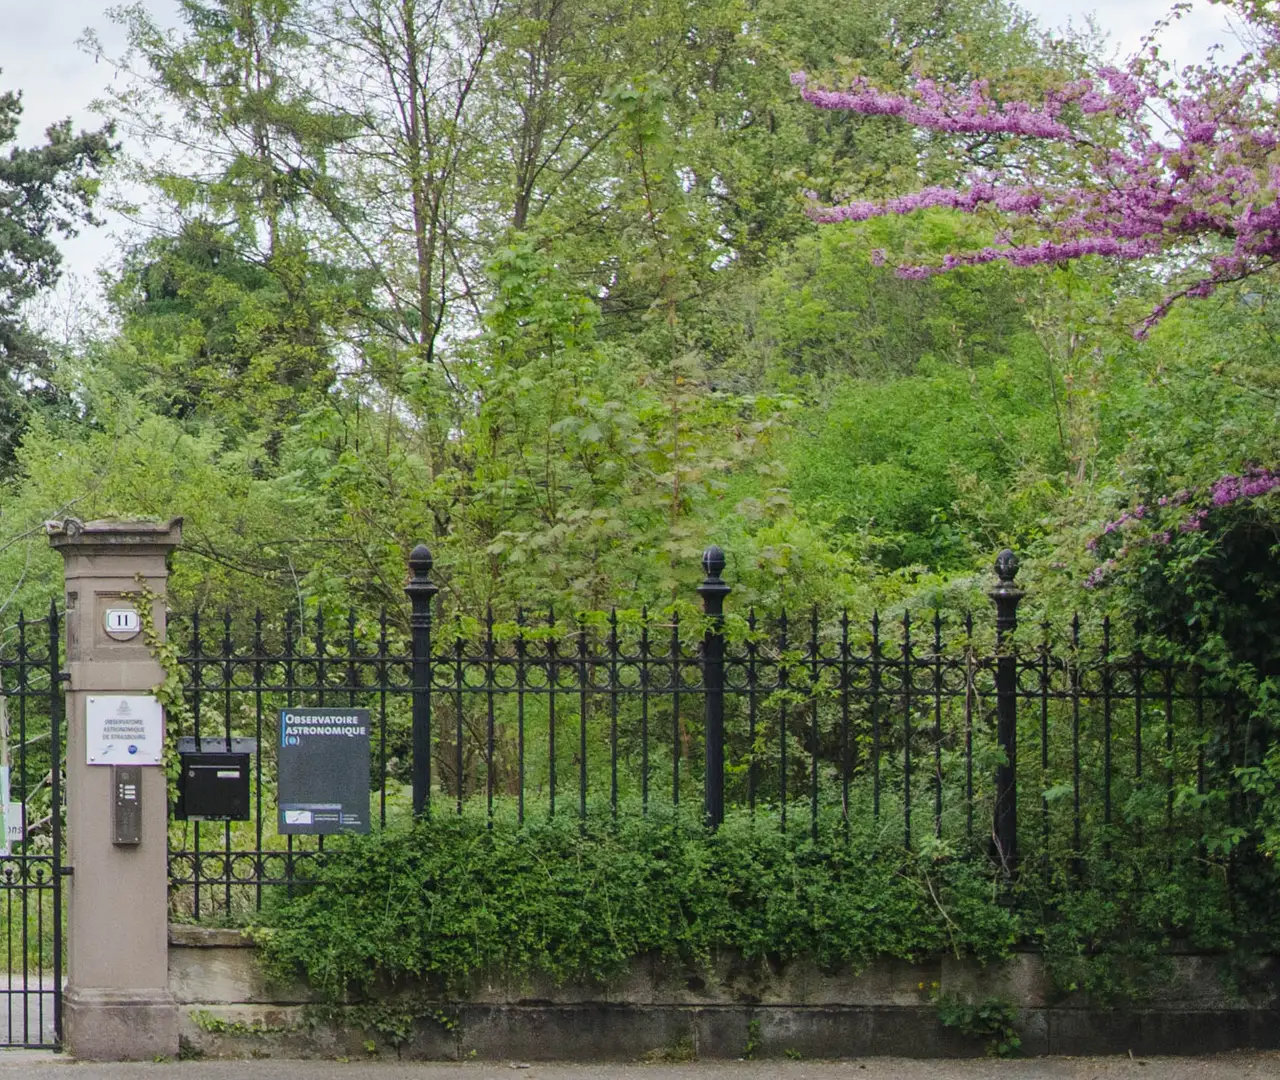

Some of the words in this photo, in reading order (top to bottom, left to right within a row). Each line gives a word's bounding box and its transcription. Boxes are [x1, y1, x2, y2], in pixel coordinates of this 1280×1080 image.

[117, 614, 128, 626] 11
[286, 714, 358, 724] OBSERVATOIRE
[286, 726, 366, 737] ASTRONOMIQUE
